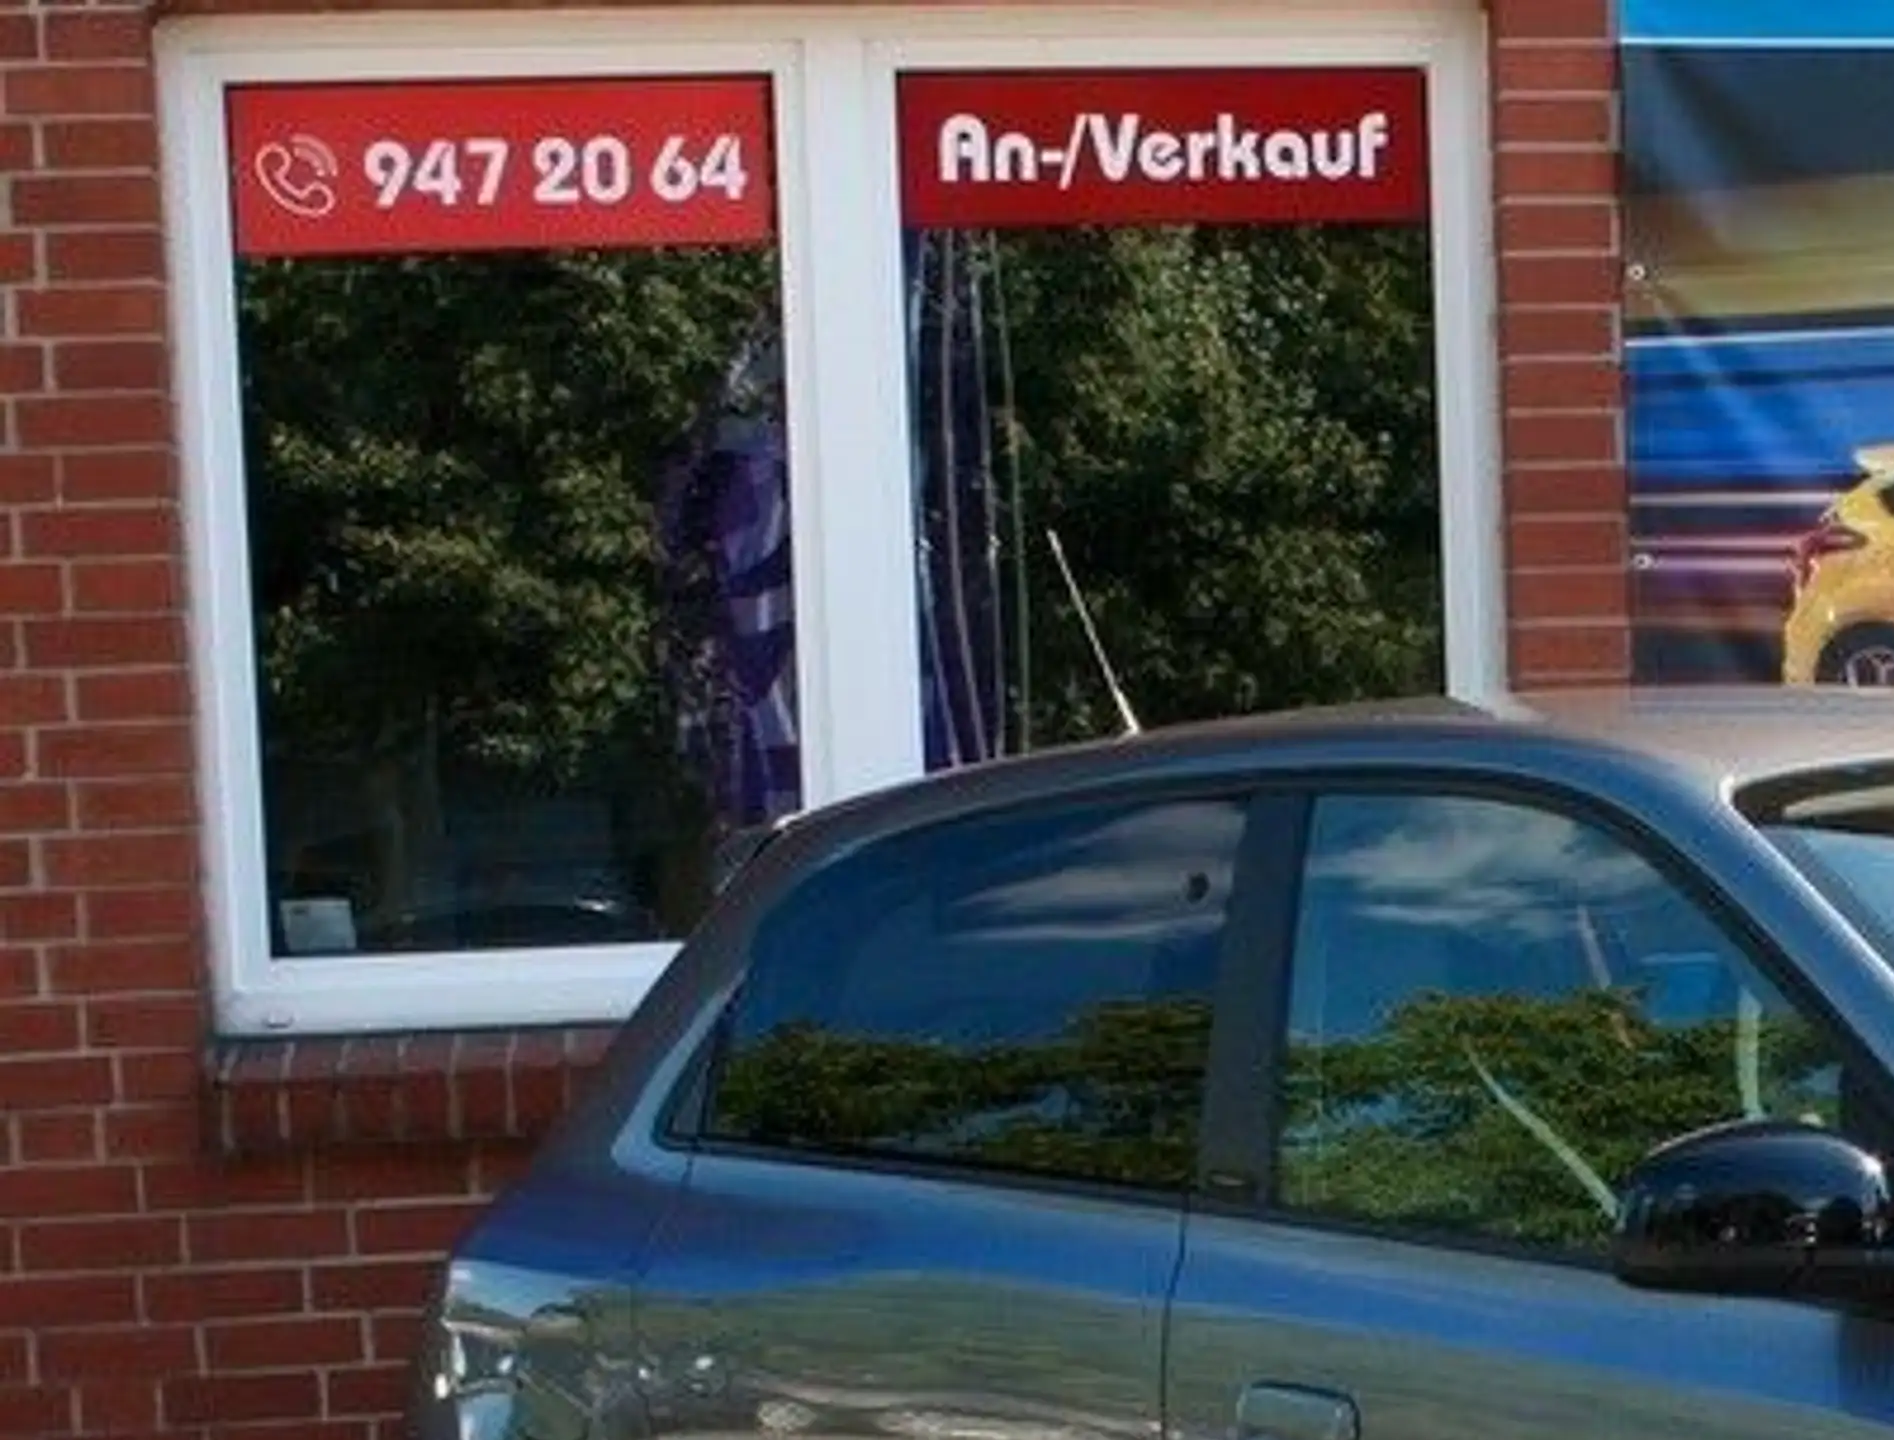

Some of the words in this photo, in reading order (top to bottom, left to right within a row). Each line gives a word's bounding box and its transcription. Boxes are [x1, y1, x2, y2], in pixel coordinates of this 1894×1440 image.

[363, 139, 510, 207] 947
[533, 136, 630, 203] 20
[650, 135, 747, 201] 64
[939, 112, 1389, 189] An-/Verkauf
